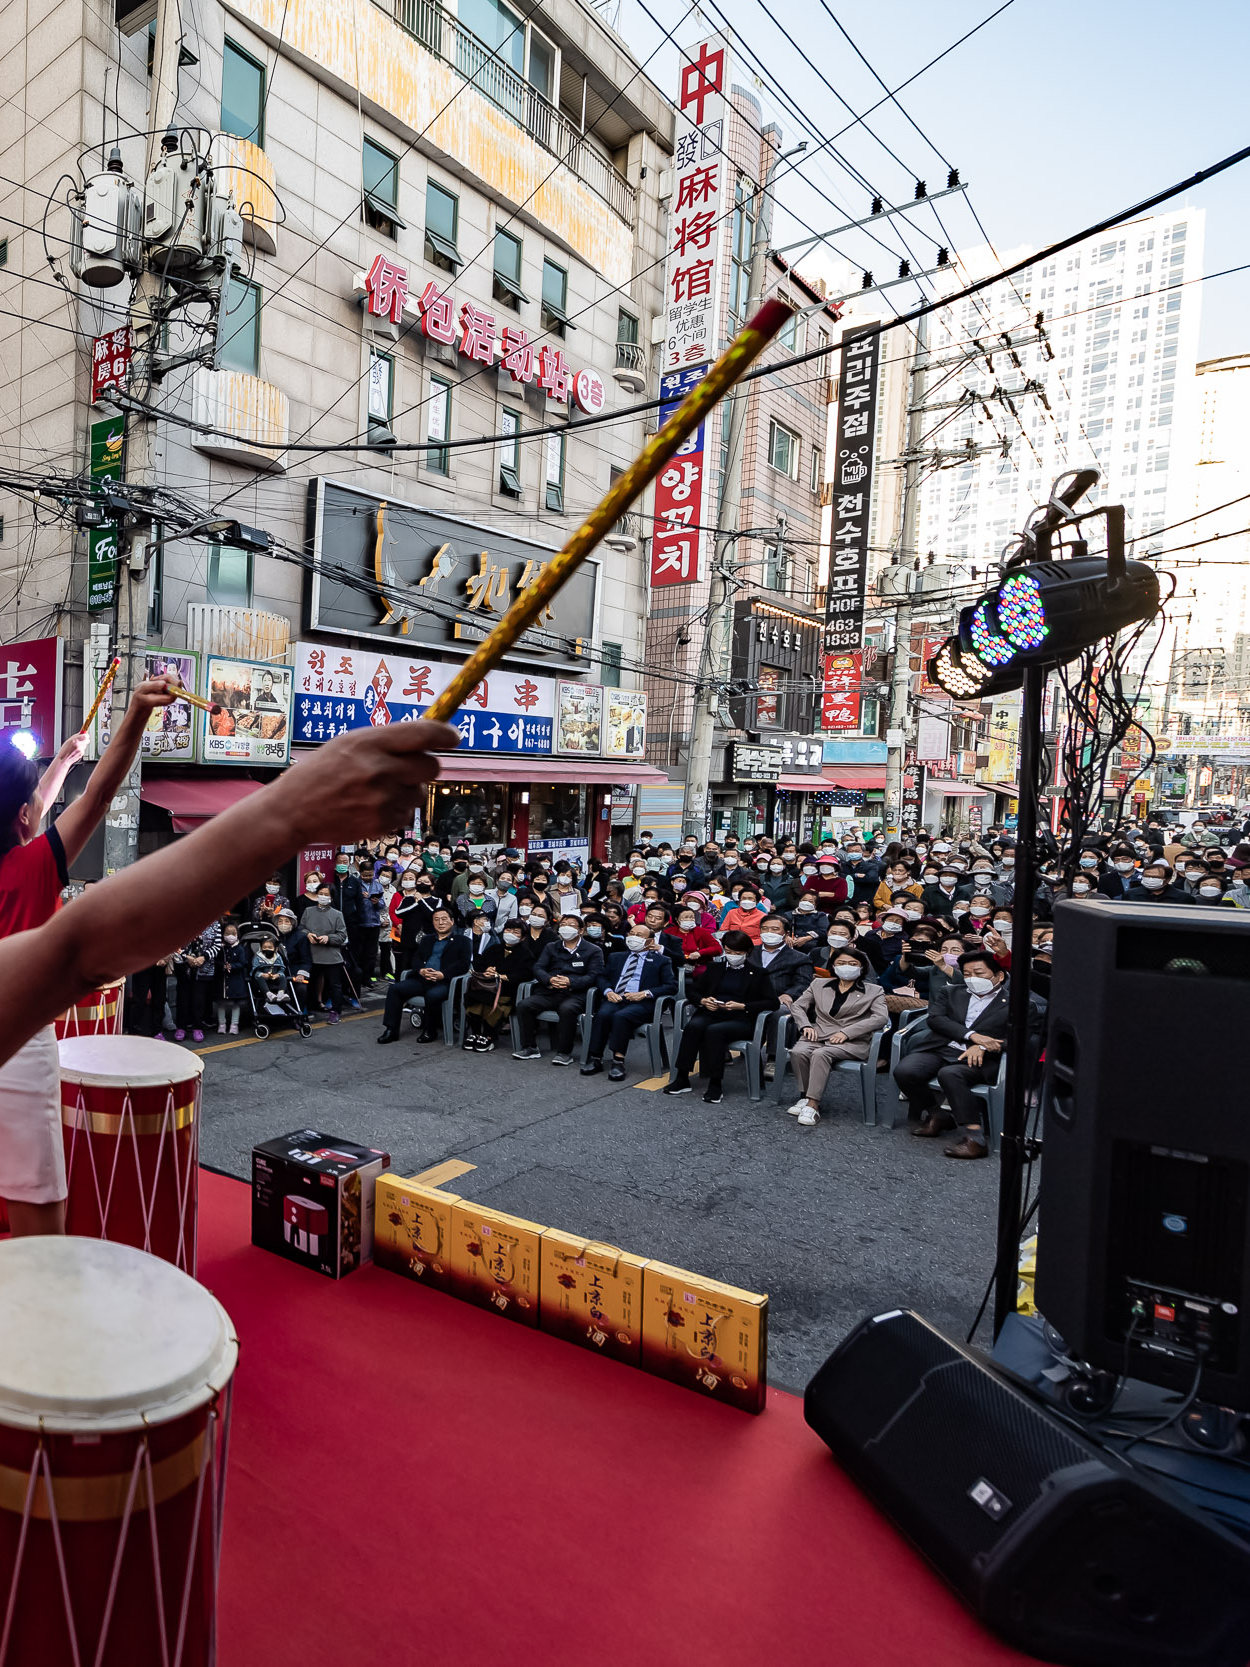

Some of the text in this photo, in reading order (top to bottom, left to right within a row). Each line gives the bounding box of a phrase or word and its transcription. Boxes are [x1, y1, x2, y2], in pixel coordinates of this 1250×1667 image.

[680, 42, 725, 126] 中
[670, 163, 720, 304] 麻将馆
[669, 297, 713, 322] 留学生
[364, 252, 605, 408] 侨包活动站 3층
[676, 313, 705, 335] 优惠
[668, 327, 708, 350] 6个间
[668, 343, 707, 366] 3층
[662, 369, 707, 390] 원조
[841, 330, 874, 438] 요리주점
[654, 461, 700, 579] 양꼬치
[832, 493, 864, 600] 천수호프
[829, 598, 861, 613] HOF
[758, 620, 802, 651] 천수호프
[825, 618, 861, 632] 463-
[825, 632, 859, 647] 1833
[307, 650, 354, 675] 원조
[302, 674, 357, 696] 건대2호점
[301, 699, 356, 720] 양꼬치거리
[302, 720, 349, 739] 선두주자
[304, 849, 332, 861] 경성양꼬치
